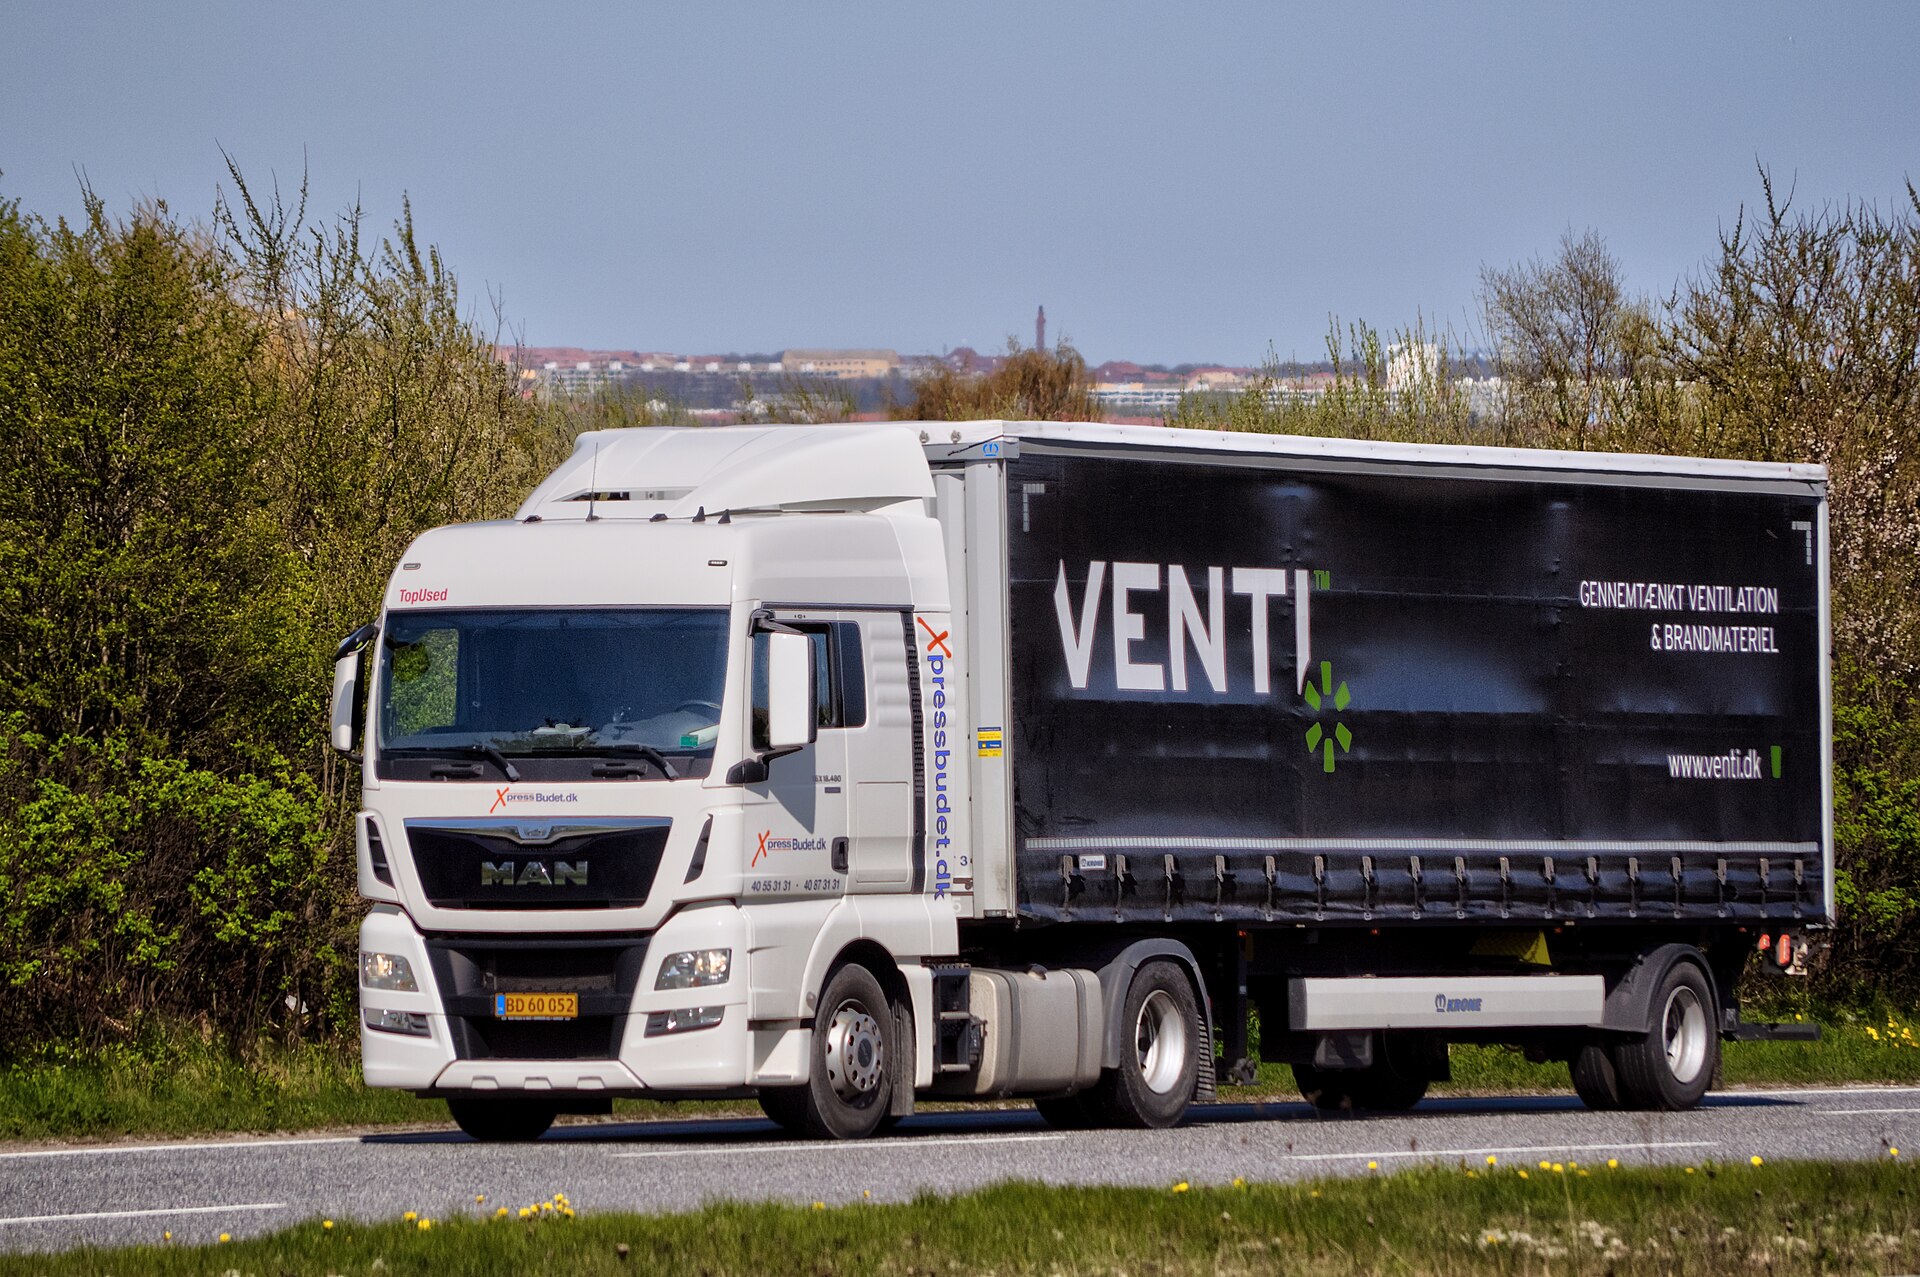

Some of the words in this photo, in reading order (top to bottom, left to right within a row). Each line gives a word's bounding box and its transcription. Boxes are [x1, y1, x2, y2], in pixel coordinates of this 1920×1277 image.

[400, 588, 448, 605] TopUsed
[1580, 580, 1685, 610] GENNEMTÆNKT
[1688, 585, 1779, 614] VENTILATION
[1054, 558, 1311, 695] VENTI
[1651, 624, 1662, 650] &
[1664, 625, 1780, 654] BRANDMATERIEL
[1667, 749, 1762, 780] www.venti.dk
[960, 855, 968, 867] 3
[481, 861, 588, 885] MAN
[751, 881, 761, 892] 40
[762, 881, 772, 892] 55
[773, 881, 781, 892] 31
[783, 881, 792, 892] 31
[803, 880, 813, 892] 40
[813, 880, 822, 891] 87
[822, 879, 831, 890] 31
[832, 879, 840, 890] 31
[506, 998, 525, 1012] BD
[528, 998, 545, 1012] 60
[548, 998, 575, 1012] 052
[1446, 998, 1482, 1012] KRONE
